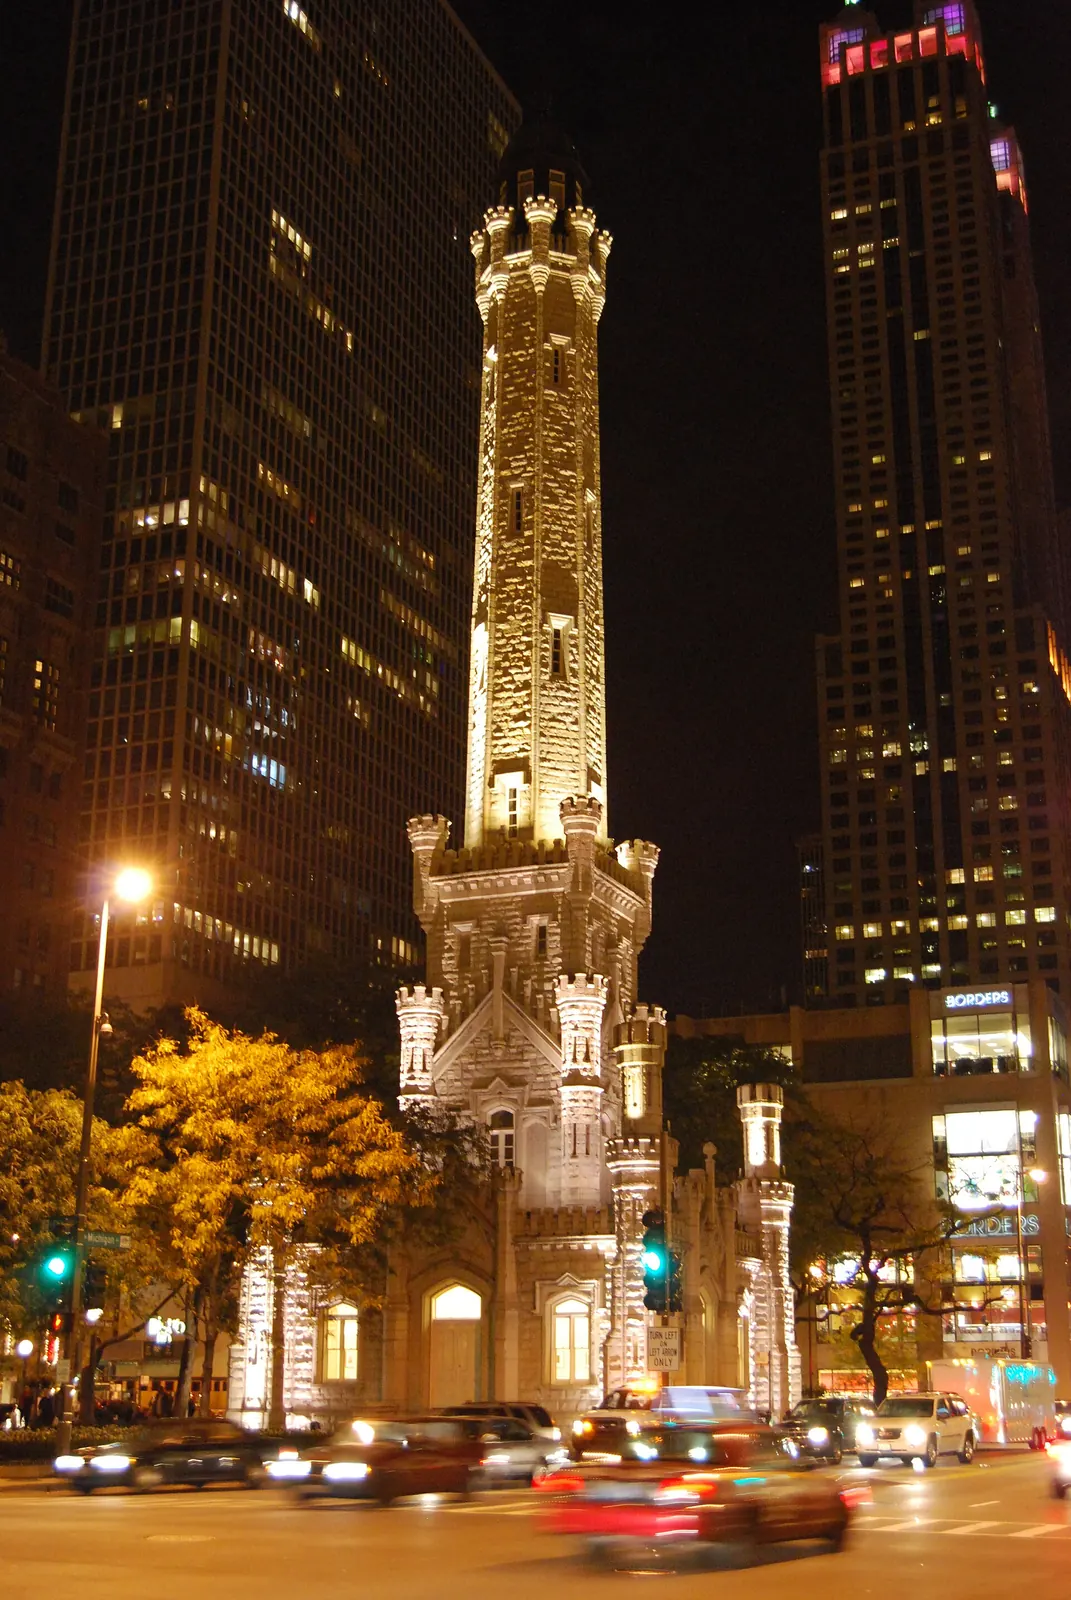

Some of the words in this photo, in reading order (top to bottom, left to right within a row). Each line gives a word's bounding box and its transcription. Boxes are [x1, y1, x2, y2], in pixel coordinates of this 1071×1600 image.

[945, 990, 1009, 1008] BORDERS
[940, 1214, 1040, 1235] ORDERS
[650, 1331, 663, 1340] TURN
[665, 1331, 678, 1340] LEFT
[650, 1348, 660, 1357] LEFT
[662, 1348, 677, 1357] ARROW
[654, 1358, 673, 1367] ONLY
